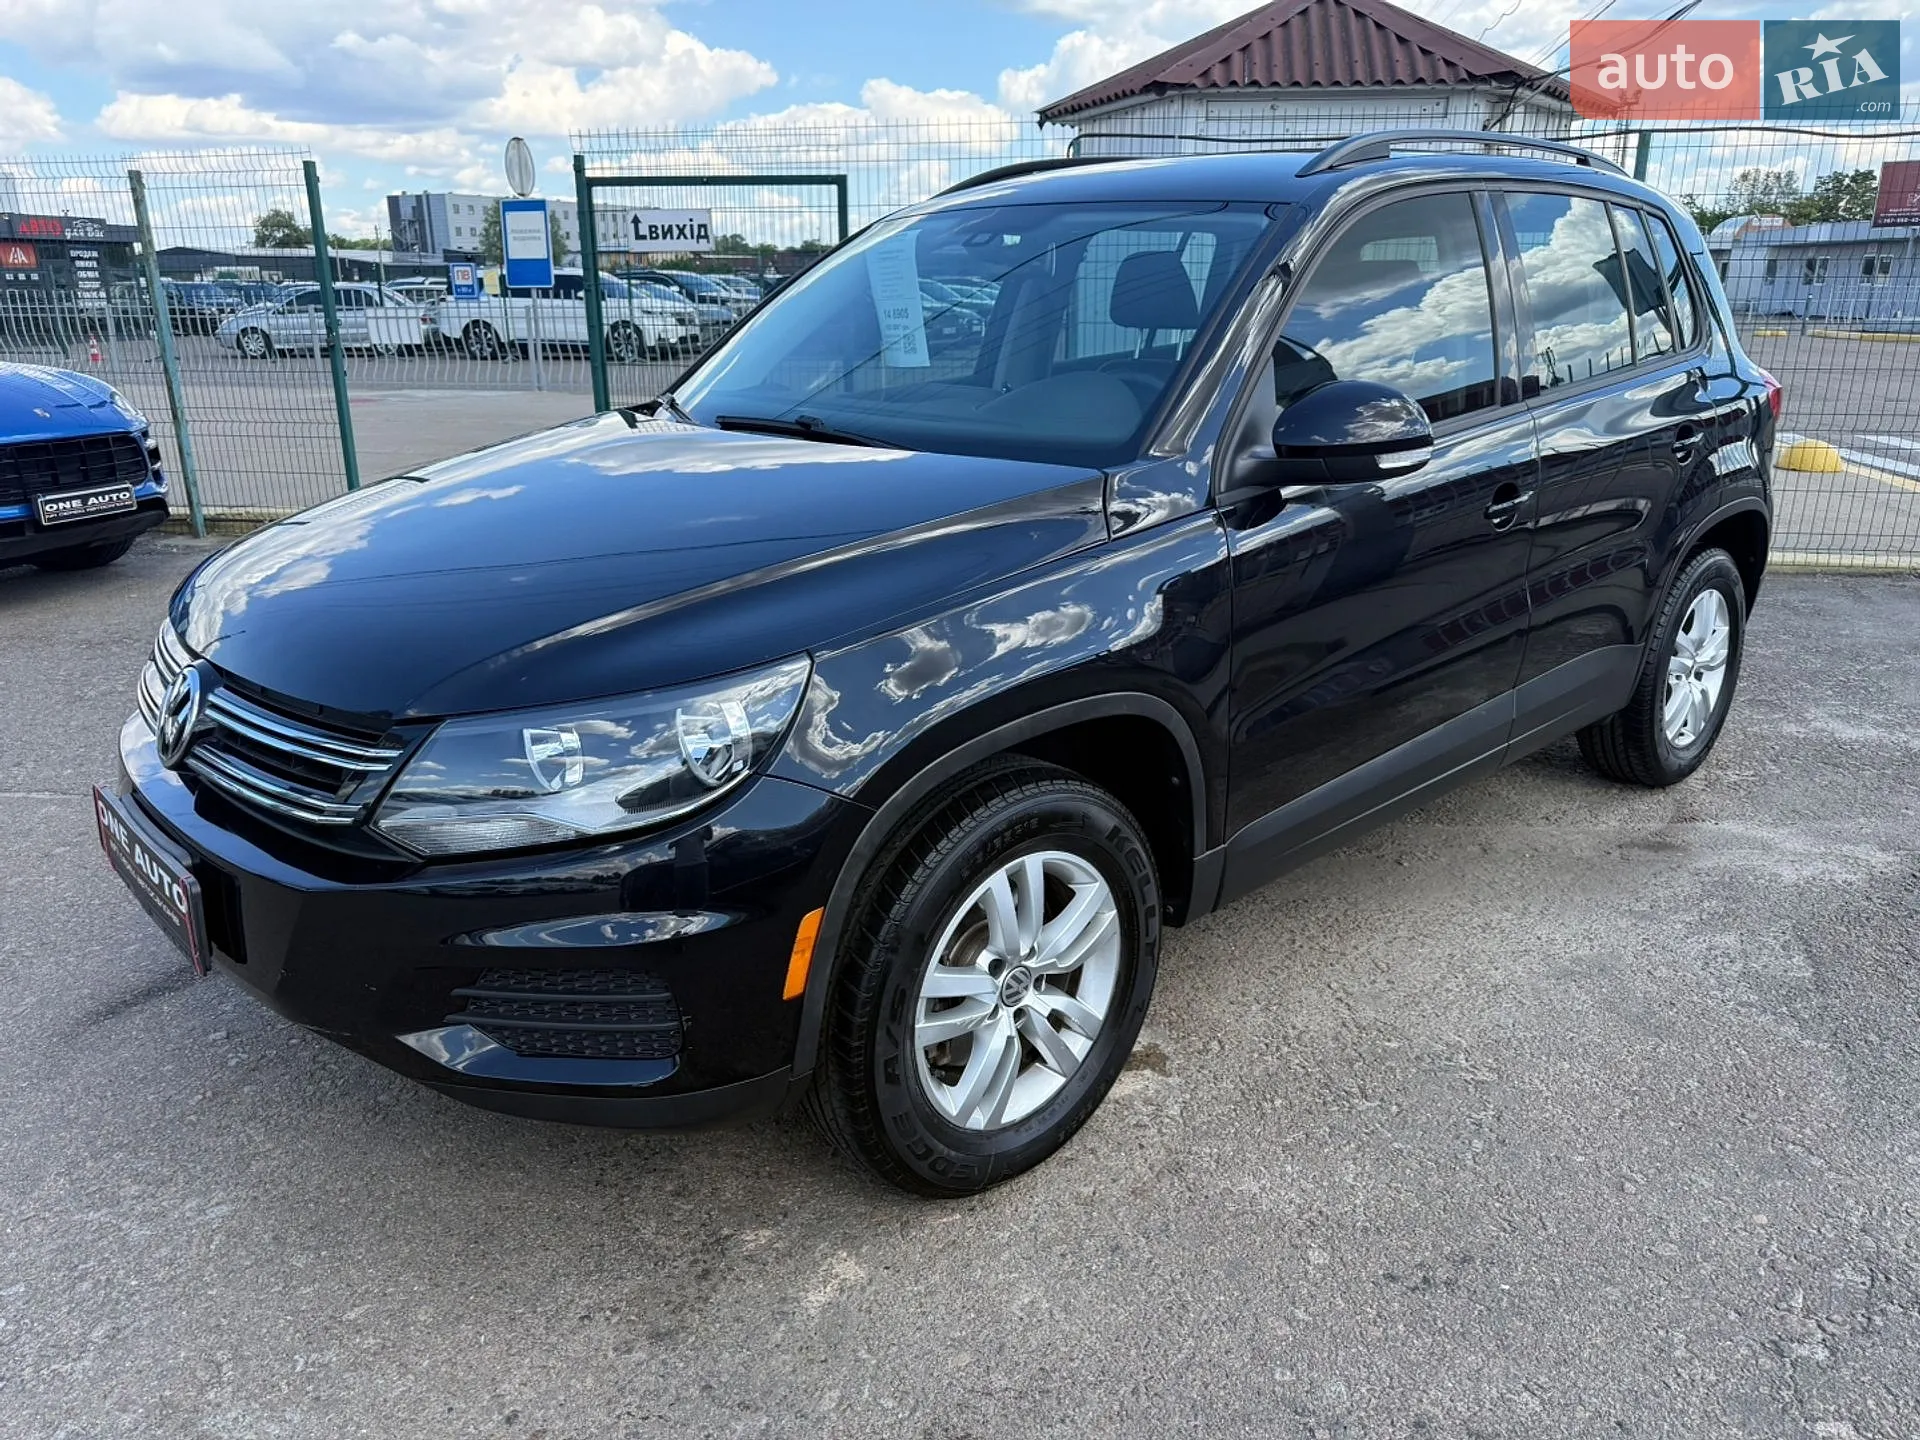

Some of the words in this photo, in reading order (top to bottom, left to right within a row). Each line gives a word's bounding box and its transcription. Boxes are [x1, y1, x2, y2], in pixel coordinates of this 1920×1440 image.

[648, 218, 710, 244] вихід
[45, 499, 83, 512] ONE
[87, 491, 131, 506] AUTO
[98, 800, 131, 853] ONE
[134, 843, 188, 914] AUTO
[1104, 824, 1158, 969] KELLY
